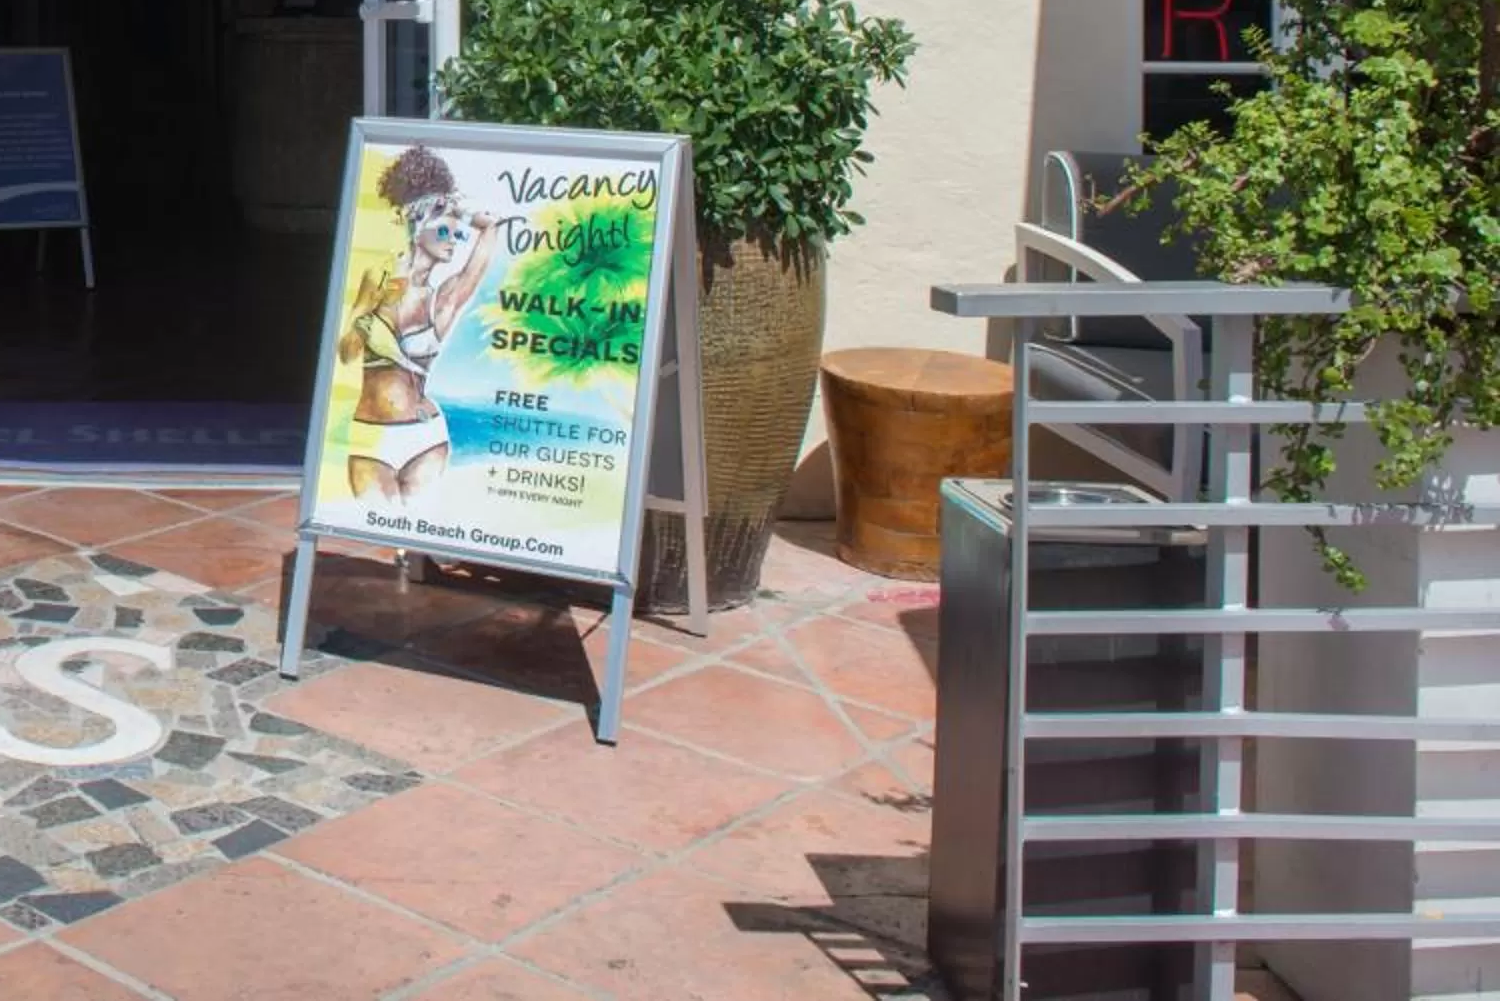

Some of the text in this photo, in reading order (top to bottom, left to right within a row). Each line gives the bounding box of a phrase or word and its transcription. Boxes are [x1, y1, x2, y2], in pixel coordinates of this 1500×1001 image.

[498, 167, 657, 210] Vacancy
[496, 212, 630, 267] Tonight!
[491, 328, 639, 364] SPECIALS
[495, 390, 549, 411] FREE
[67, 424, 304, 445] SHELLE
[491, 415, 627, 446] SHUTTLE FOR
[489, 440, 615, 471] OUR GUESTS
[507, 468, 585, 493] DRINKS!
[366, 511, 412, 532] South
[416, 519, 465, 541] Beach
